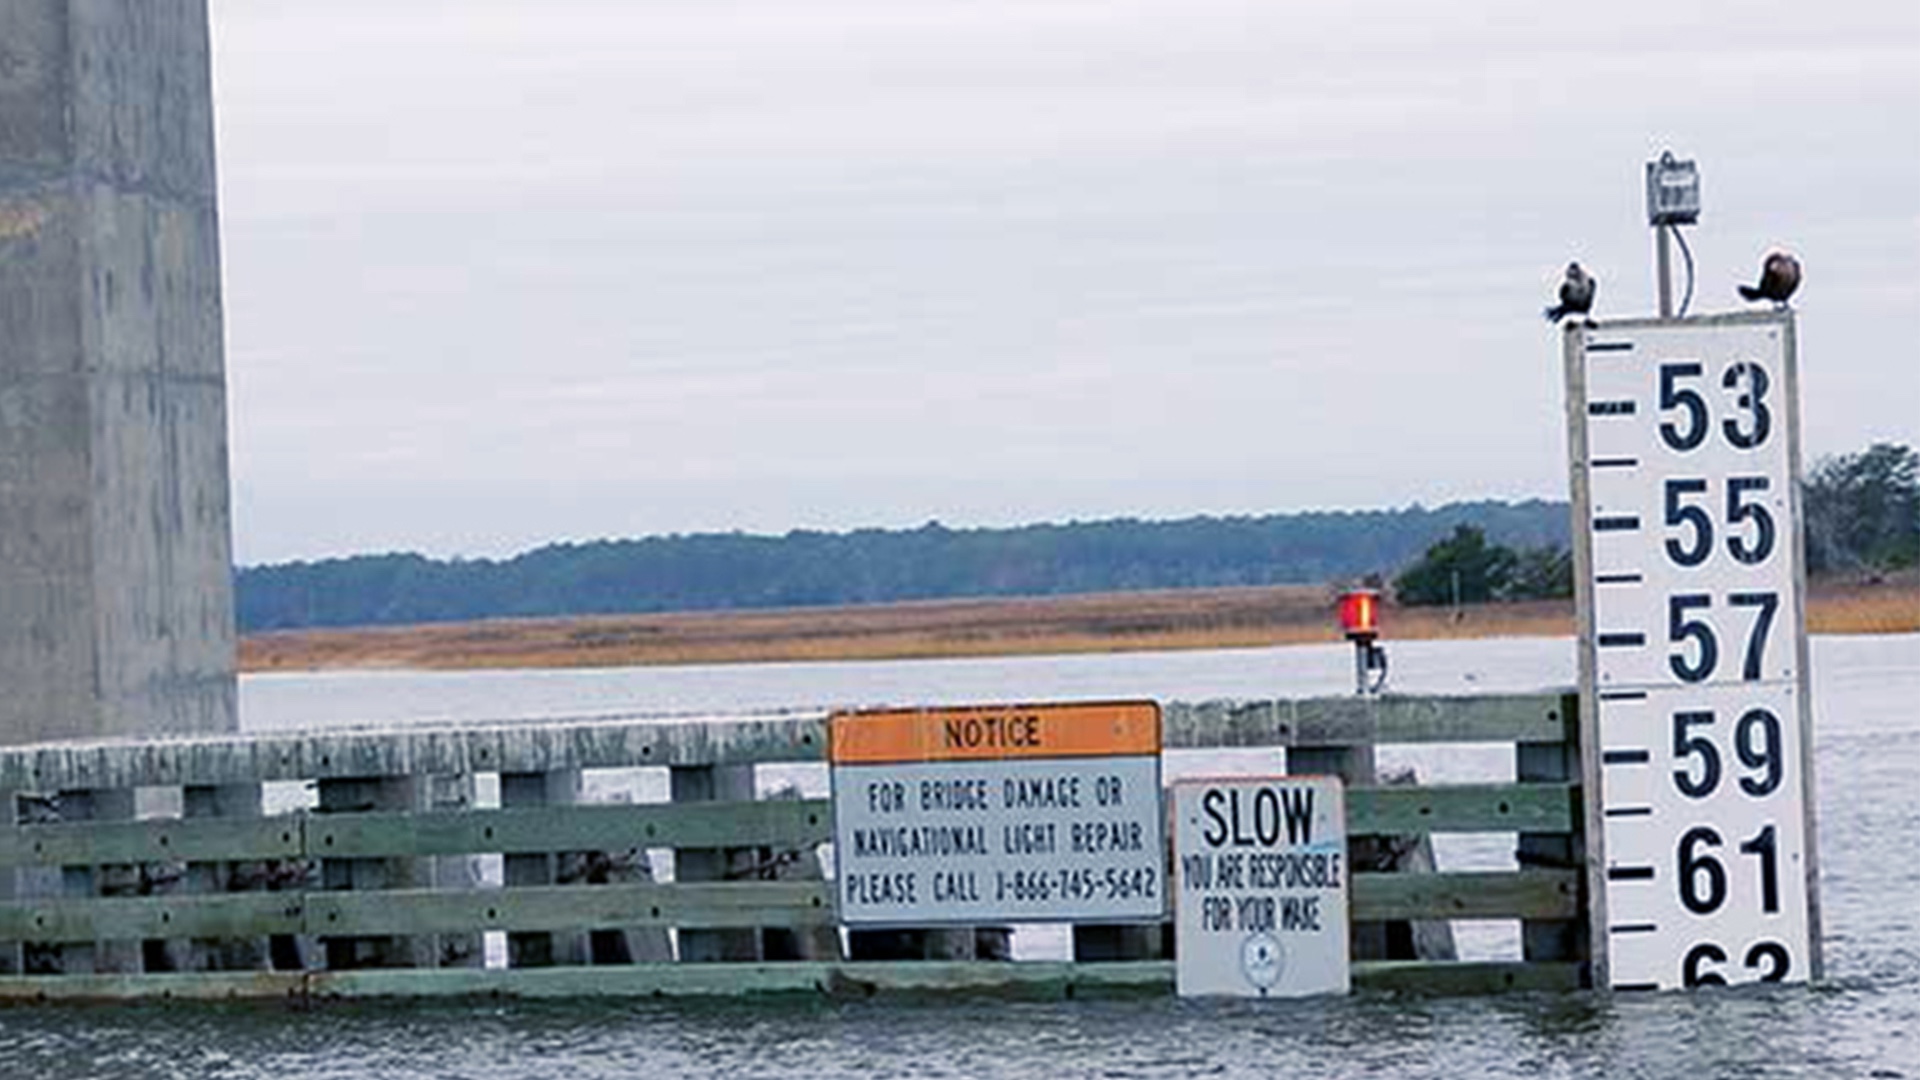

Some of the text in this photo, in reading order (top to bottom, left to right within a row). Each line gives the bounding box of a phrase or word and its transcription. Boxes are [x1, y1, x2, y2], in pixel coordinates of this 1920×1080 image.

[1658, 361, 1771, 451] 53
[1664, 476, 1776, 567] 55
[1668, 592, 1778, 682] 57
[945, 716, 1041, 748] NOTICE
[1673, 708, 1784, 799] 59
[868, 775, 1122, 812] FOR BRIDGE DAMAGE OR
[1203, 788, 1313, 847] SLOW
[853, 821, 1143, 857] NAVIGATIONAL LIGHT REPAIR
[847, 873, 917, 904] PLEASE
[932, 870, 980, 901] CALL
[1181, 854, 1212, 890] YOU
[1215, 853, 1244, 889] ARE
[1677, 824, 1779, 915] 61
[1203, 894, 1321, 932] FOR YOUR WAKE
